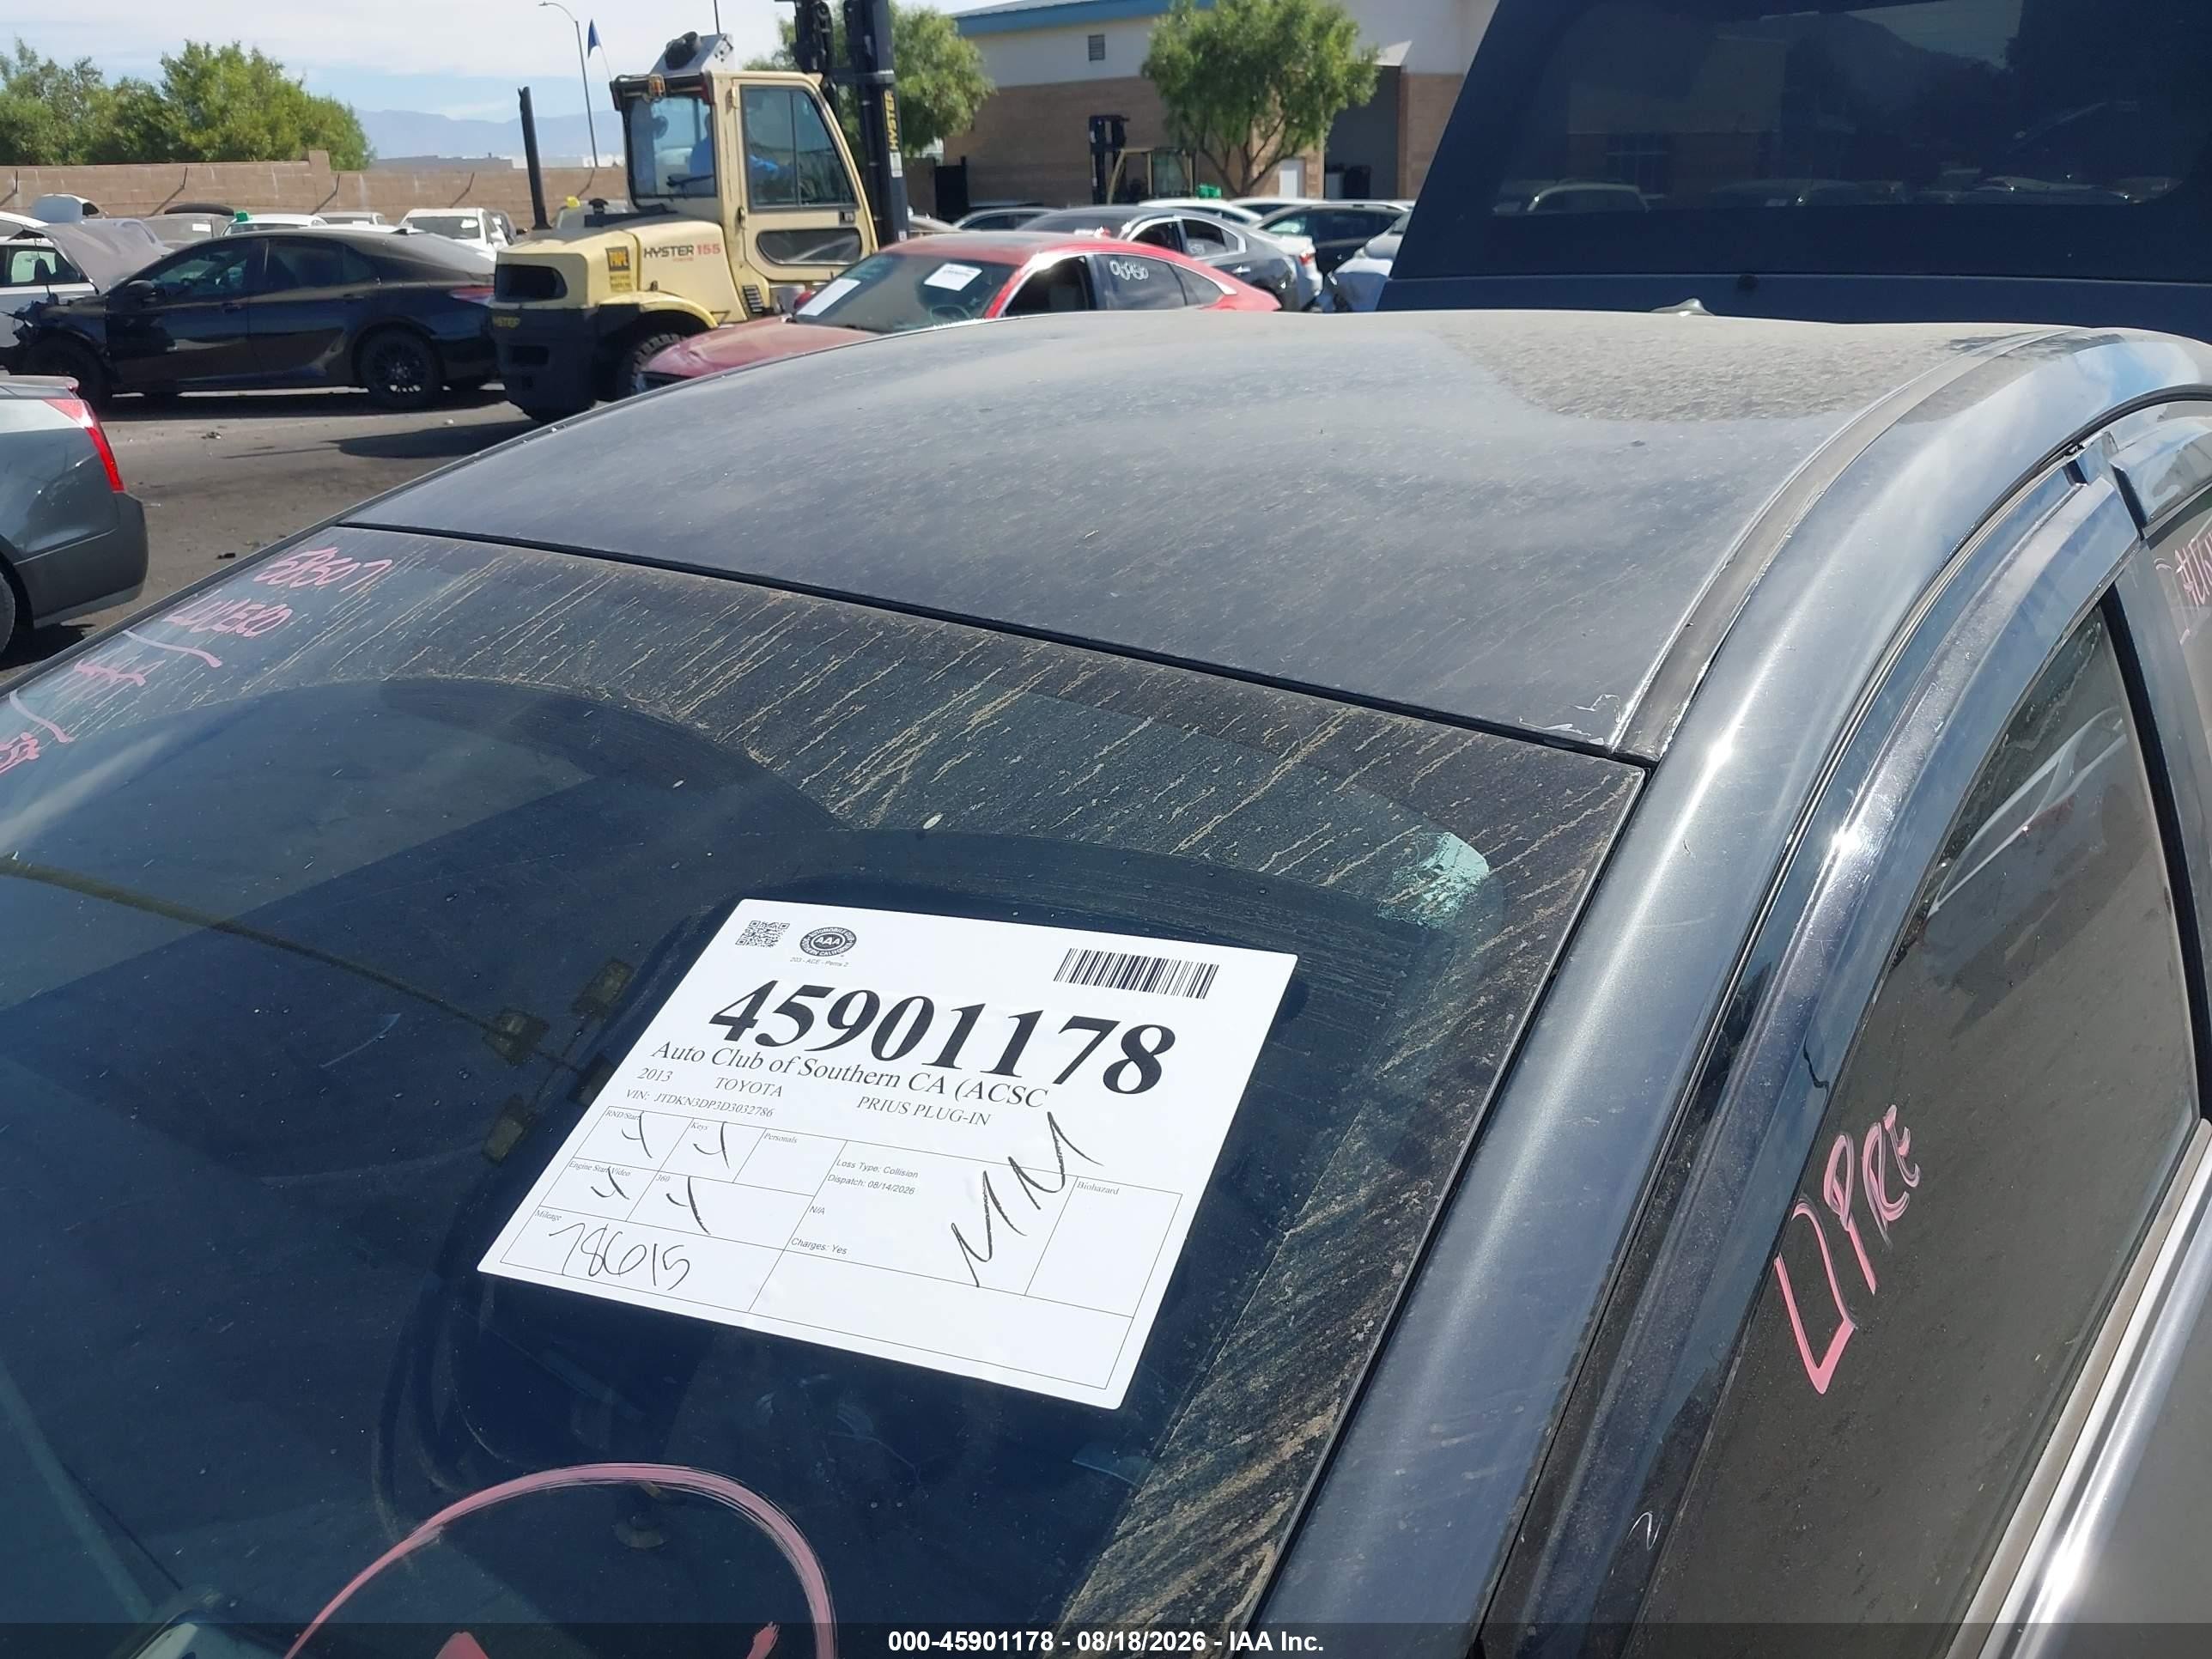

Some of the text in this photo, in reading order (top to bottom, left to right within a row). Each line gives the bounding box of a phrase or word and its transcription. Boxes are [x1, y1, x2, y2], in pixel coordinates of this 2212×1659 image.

[884, 89, 899, 151] HYSTER
[643, 244, 721, 258] HYSTER 155
[814, 936, 841, 946] AAA
[708, 980, 1176, 1095] 45901178
[649, 1041, 1049, 1109] Auto Club of Southern CA (ACSC
[626, 1089, 776, 1118] VIN: JTDKN3DP3D3032786
[636, 1067, 992, 1127] 2013 TOYOTA PRIUS PLUG-IN
[690, 1121, 709, 1132] Keys
[763, 1132, 799, 1145] Personals
[568, 1161, 592, 1172] Engine
[836, 1158, 919, 1179] Loss Type: Collision
[655, 1174, 671, 1183] 360
[827, 1174, 916, 1195] Dispatch: 08/14/2026
[1077, 1181, 1120, 1195] Biohazard
[534, 1210, 562, 1221] Mileage
[809, 1206, 825, 1215] N/A
[791, 1237, 848, 1255] Charges: Yes
[549, 1223, 690, 1291] 78615
